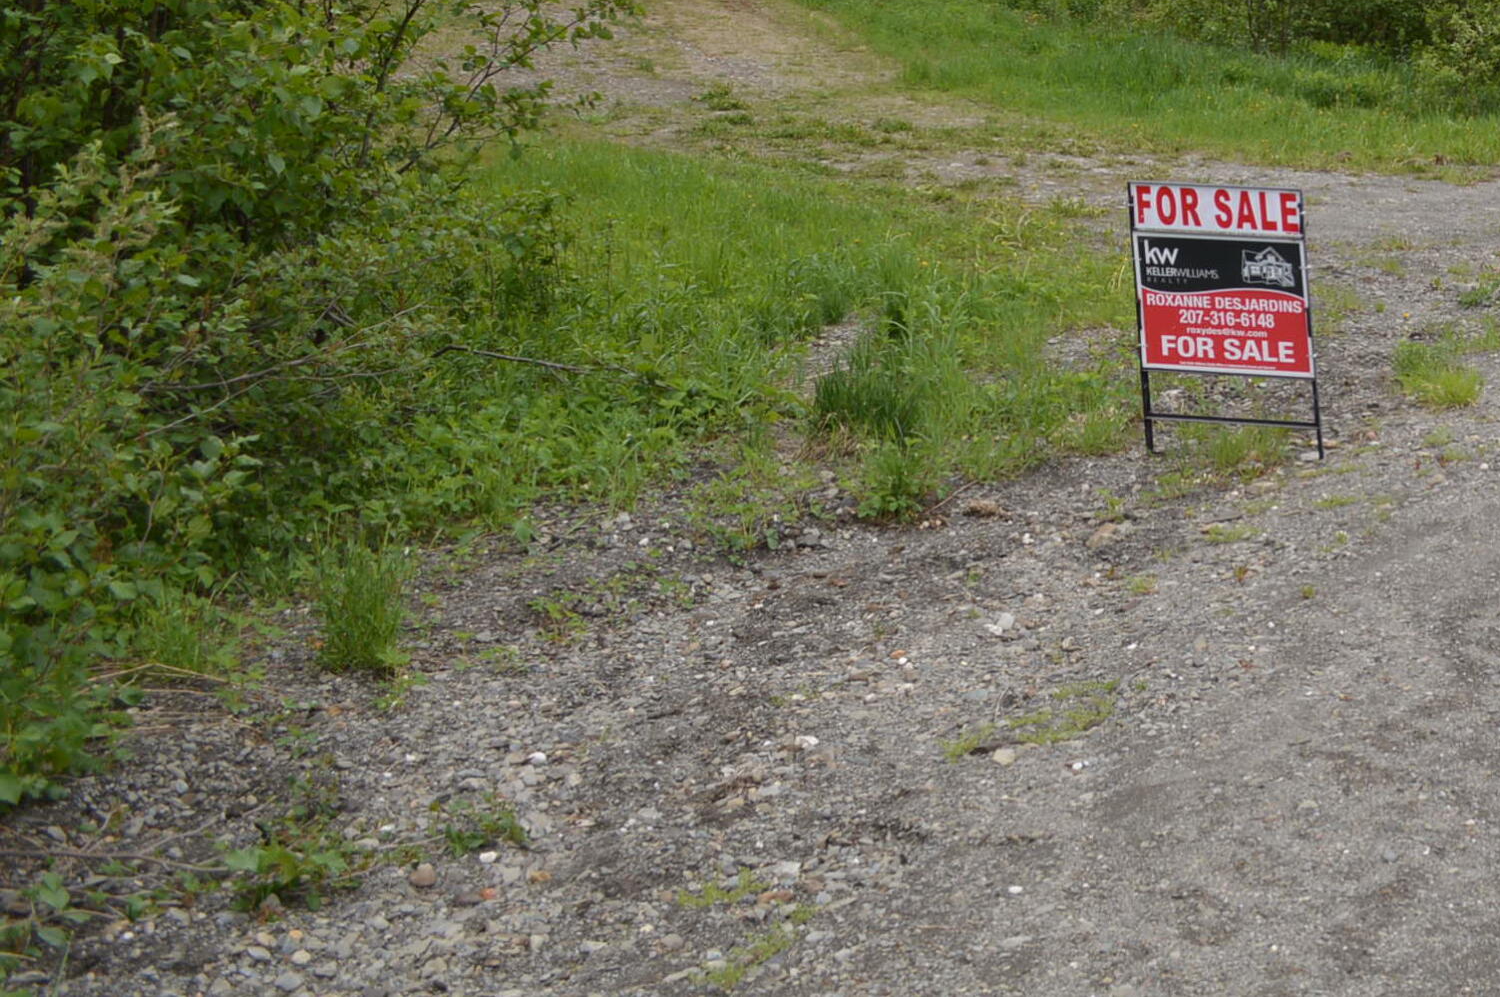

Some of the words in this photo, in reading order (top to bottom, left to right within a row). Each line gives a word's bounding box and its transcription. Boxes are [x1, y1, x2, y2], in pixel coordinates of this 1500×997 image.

[1136, 185, 1201, 226] FOR
[1214, 189, 1300, 232] SALE
[1146, 293, 1211, 308] ROXANNE
[1215, 297, 1302, 313] DESJARDINS
[1179, 309, 1275, 328] 207-316-6148
[1161, 335, 1215, 358] FOR
[1224, 338, 1296, 363] SALE
